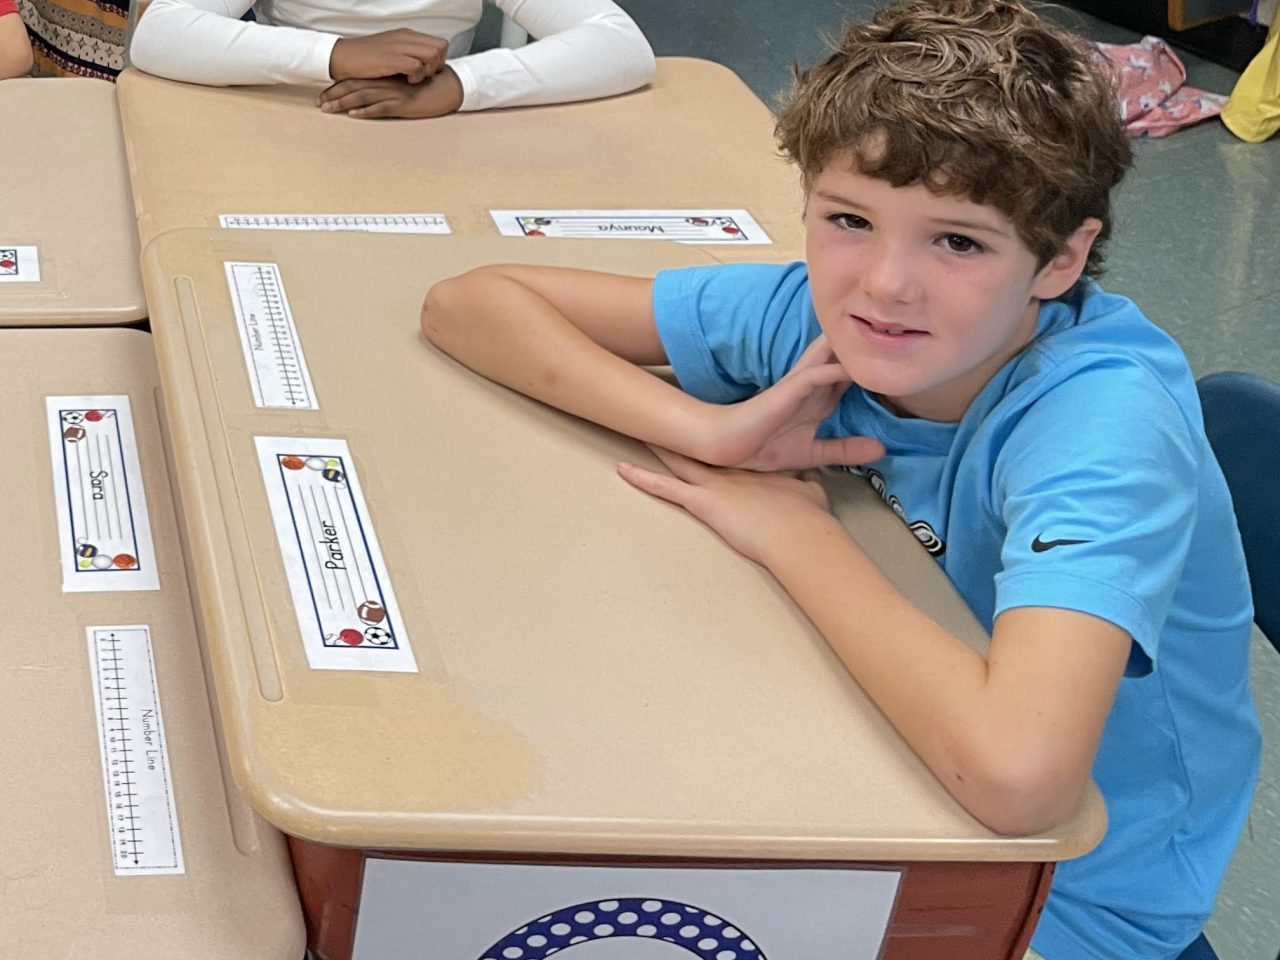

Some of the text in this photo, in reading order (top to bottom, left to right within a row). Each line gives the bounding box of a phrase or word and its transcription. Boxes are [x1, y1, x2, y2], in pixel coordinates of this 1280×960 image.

[248, 313, 264, 351] Number Line
[90, 470, 108, 500] Sara
[318, 520, 347, 570] Parker
[140, 709, 158, 770] Number Line
